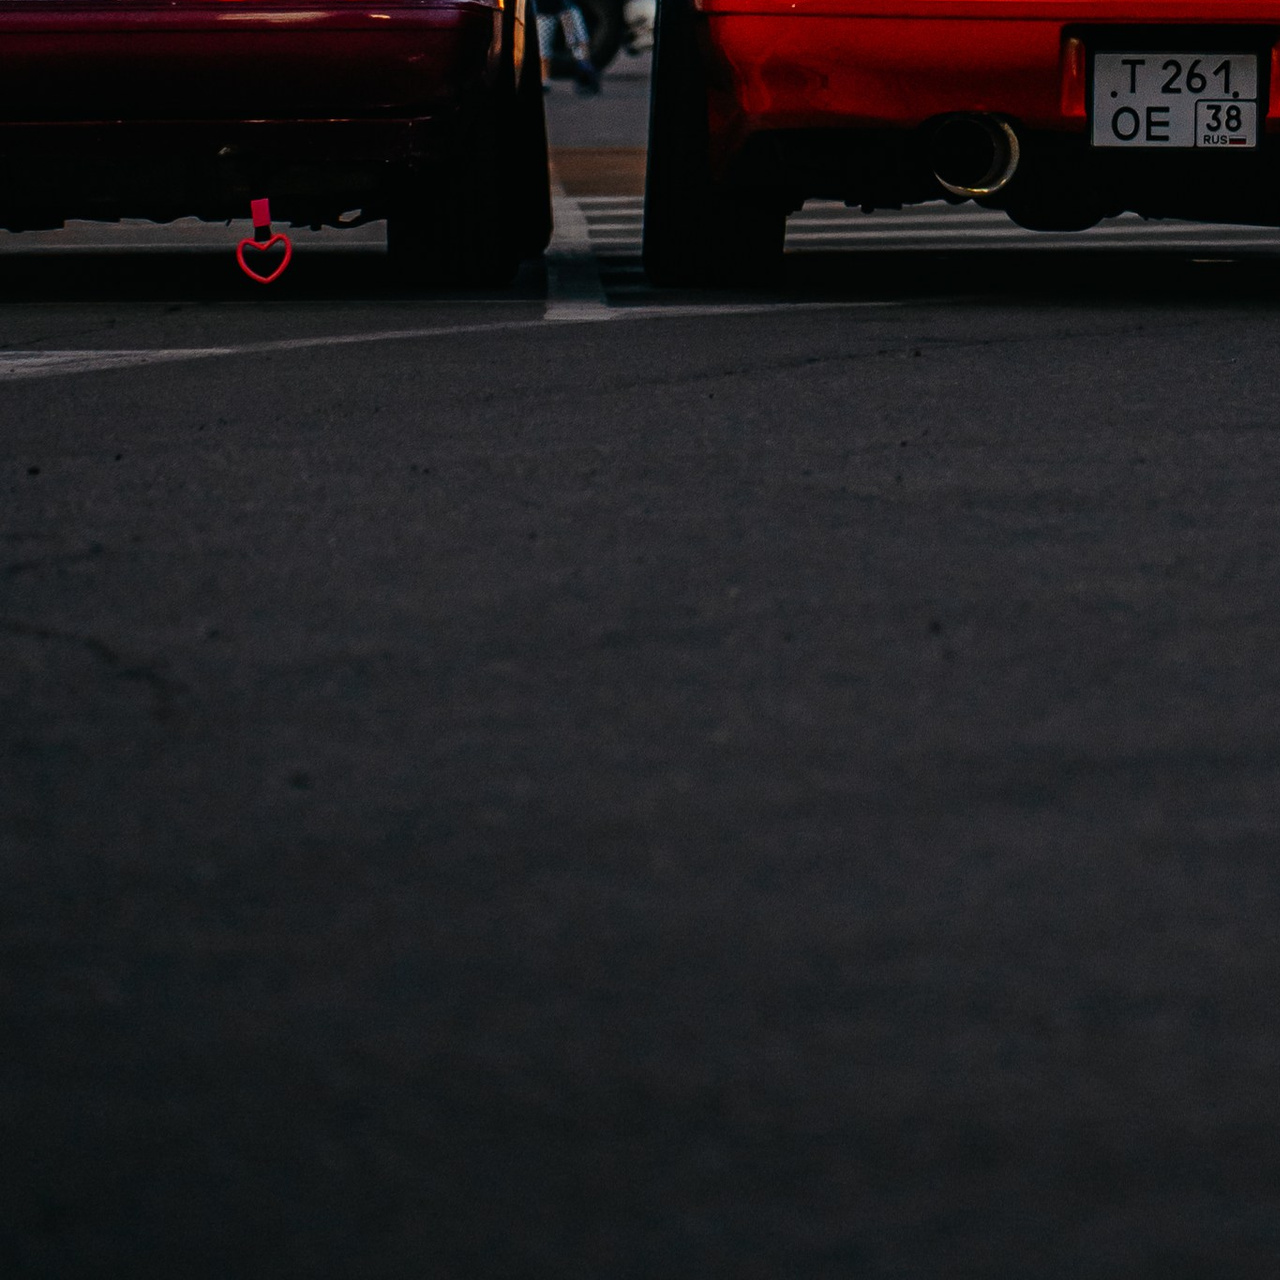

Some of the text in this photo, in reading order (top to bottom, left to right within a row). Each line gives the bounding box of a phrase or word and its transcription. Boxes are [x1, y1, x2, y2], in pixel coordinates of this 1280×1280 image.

[1161, 59, 1232, 94] 261
[1205, 104, 1242, 132] 38
[1203, 135, 1228, 145] RUS
